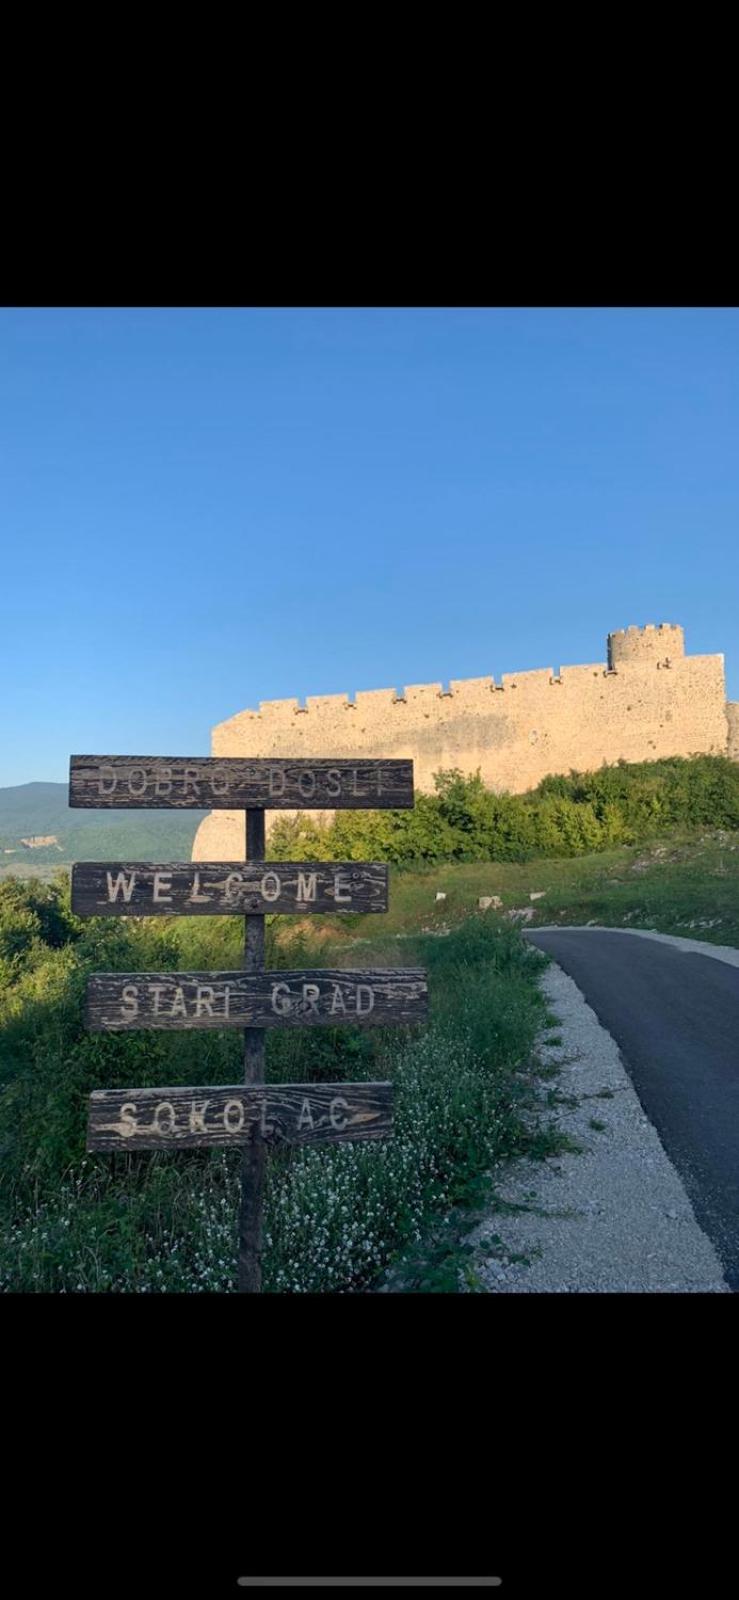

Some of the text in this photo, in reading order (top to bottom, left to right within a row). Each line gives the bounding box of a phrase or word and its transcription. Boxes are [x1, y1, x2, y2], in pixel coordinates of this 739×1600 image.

[98, 766, 384, 798] DOBRO DOSLI
[106, 871, 353, 903] WELCOME
[121, 982, 375, 1018] STARI GRAD
[119, 1098, 352, 1137] SOKOLAC
